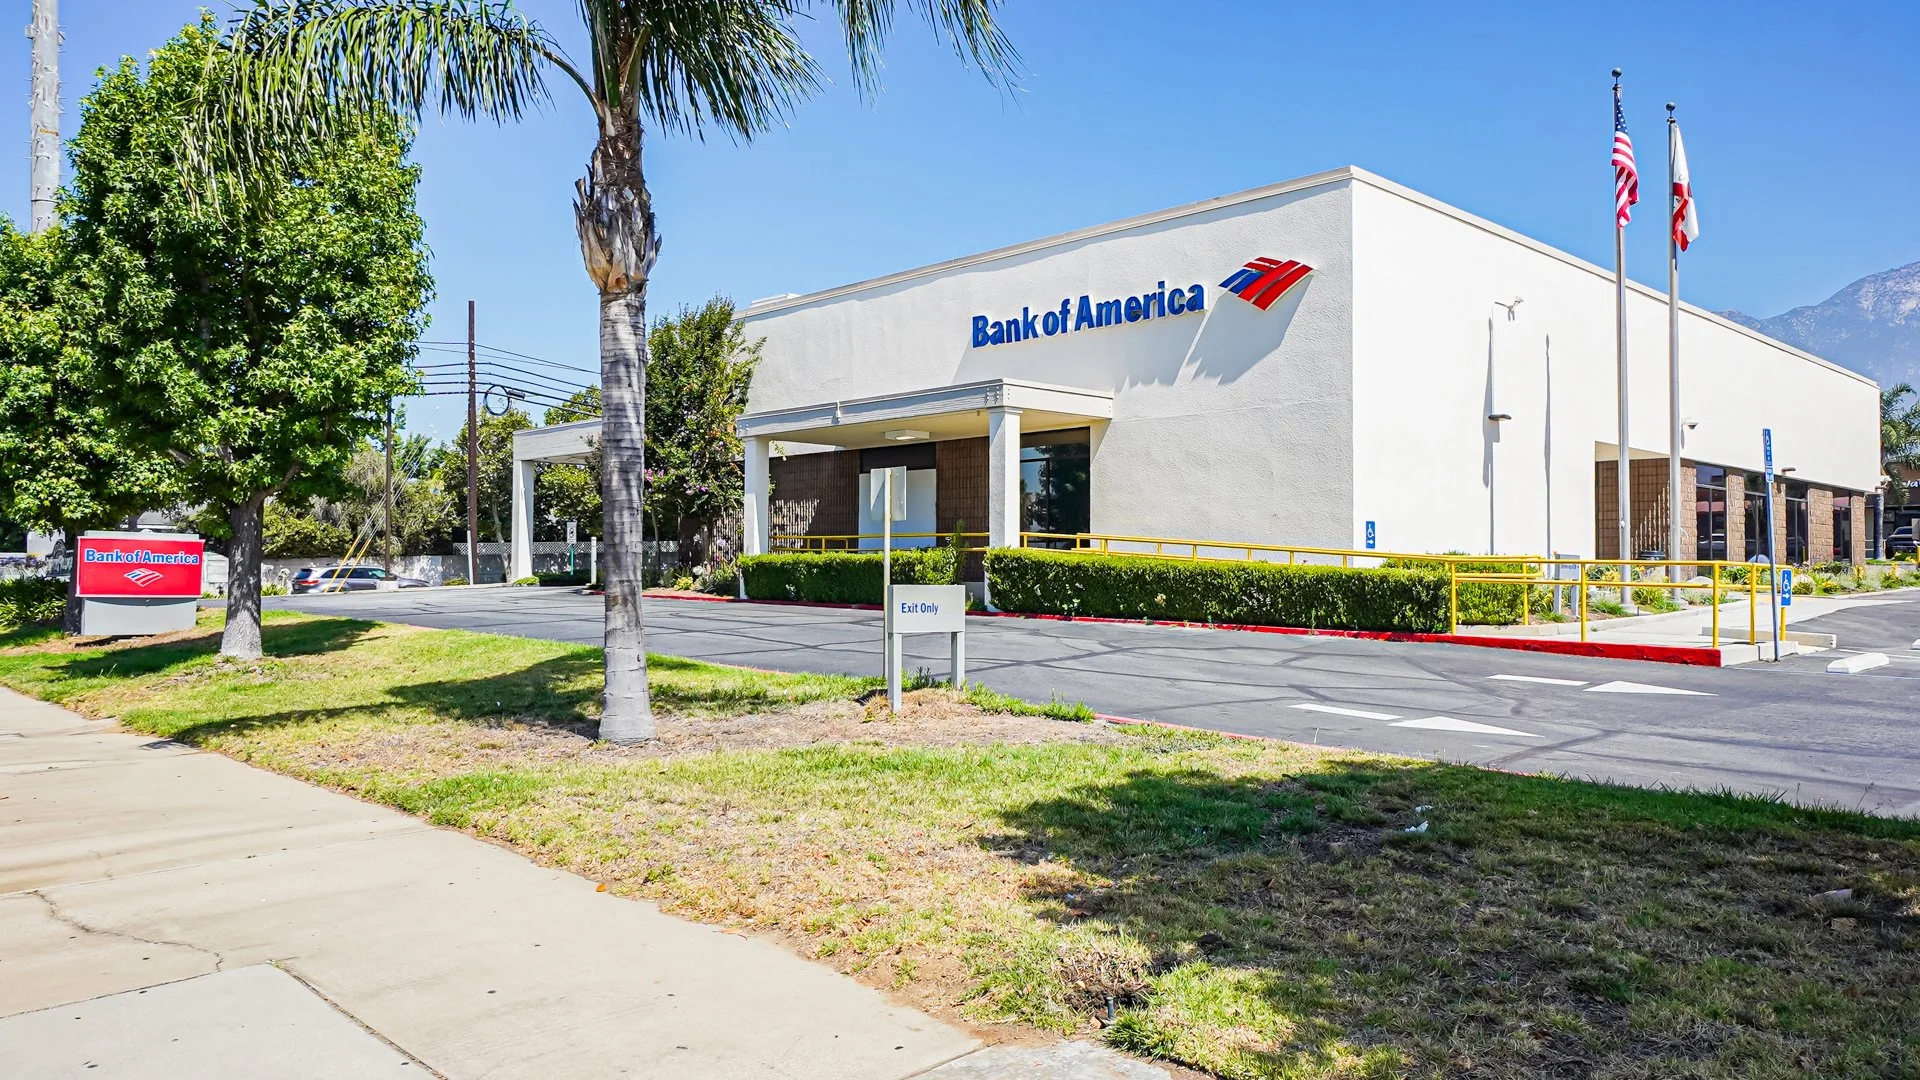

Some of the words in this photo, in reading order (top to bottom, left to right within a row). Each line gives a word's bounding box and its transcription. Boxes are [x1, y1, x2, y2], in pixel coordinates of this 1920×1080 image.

[972, 307, 1039, 348] Bank
[1042, 298, 1071, 337] of
[1074, 280, 1205, 331] America
[85, 548, 124, 562] Bank
[125, 550, 141, 563] of
[142, 549, 199, 564] America
[901, 602, 919, 613] Exit
[920, 602, 939, 615] Only
